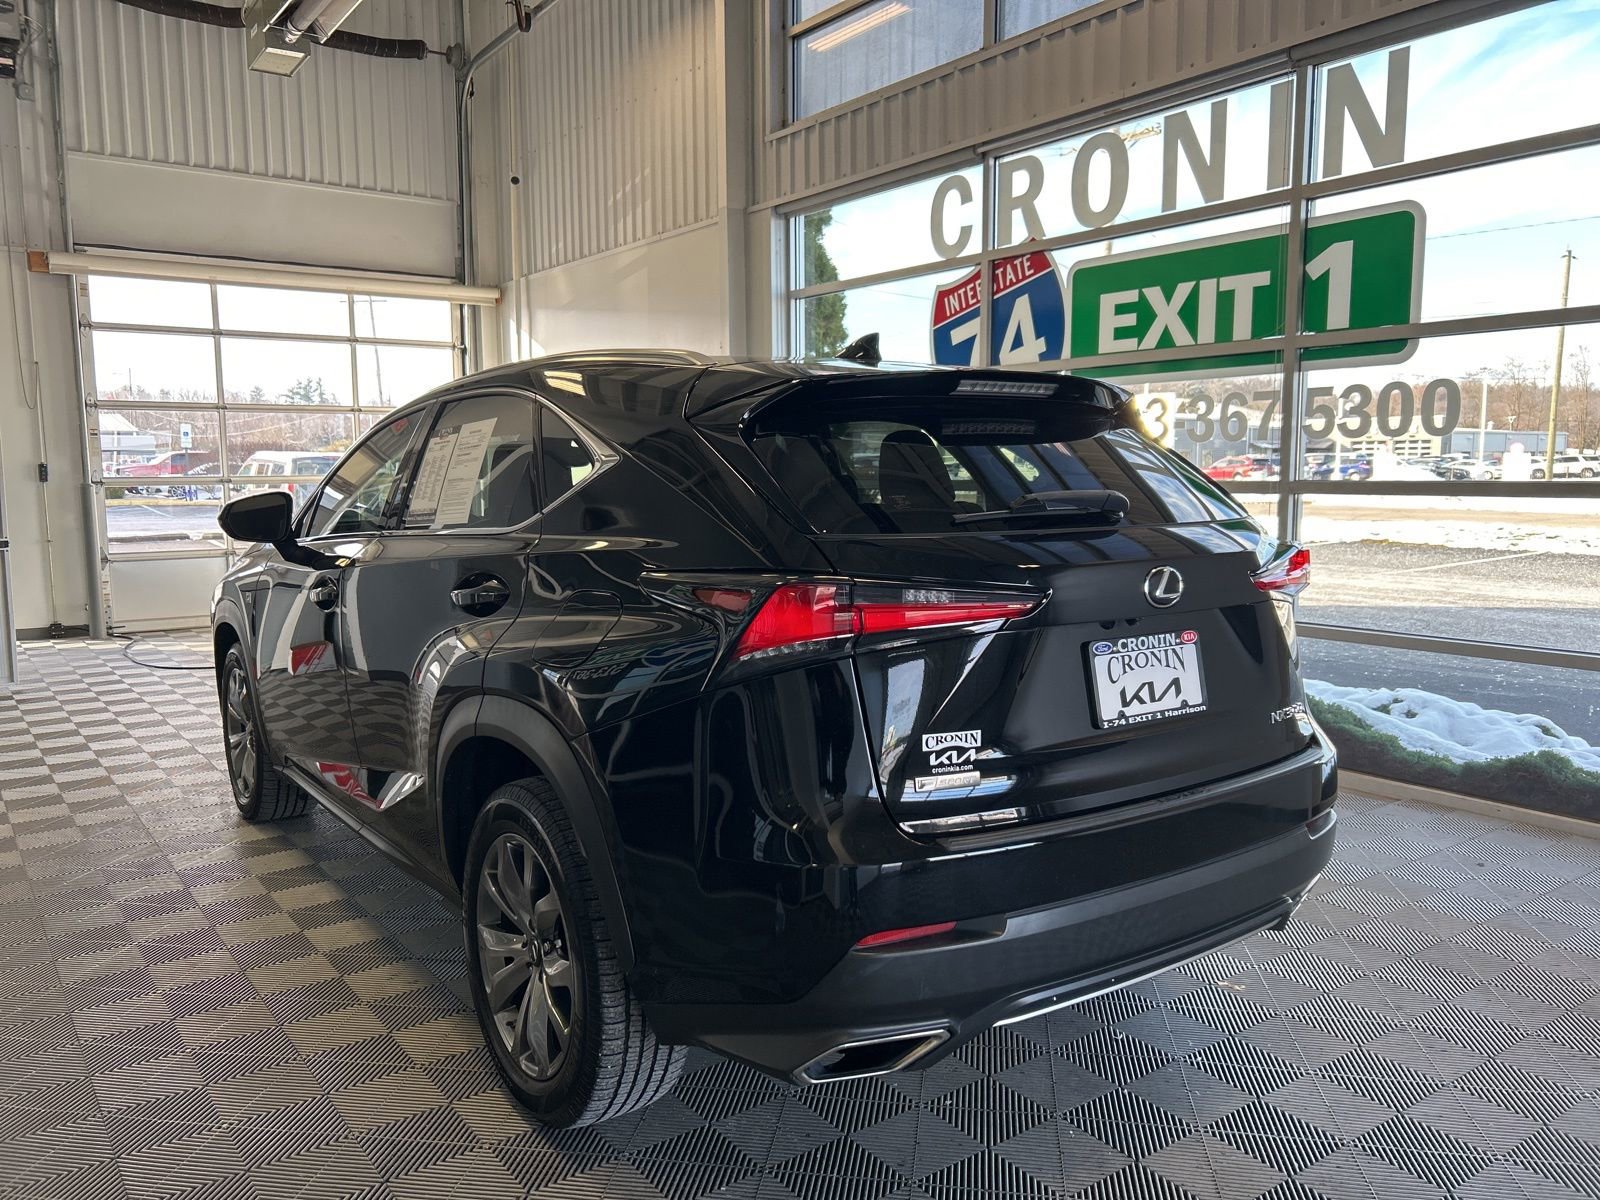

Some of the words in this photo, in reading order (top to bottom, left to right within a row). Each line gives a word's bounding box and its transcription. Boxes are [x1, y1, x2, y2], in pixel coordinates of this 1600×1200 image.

[930, 46, 1411, 259] CRONIN
[944, 254, 1035, 317] INTETATE
[1098, 270, 1272, 353] EXIT
[1305, 240, 1354, 330] 1
[950, 293, 1047, 367] 74
[1117, 633, 1176, 652] CRONIN
[1107, 646, 1186, 684] CRONIN
[1119, 677, 1182, 708] KIA
[1103, 718, 1126, 728] I-74
[1128, 713, 1154, 724] EXIT
[1156, 711, 1163, 719] 1
[1164, 705, 1207, 718] Harrison
[925, 731, 979, 749] CRONIN
[930, 749, 976, 766] KIA
[932, 764, 974, 774] croninkia.com
